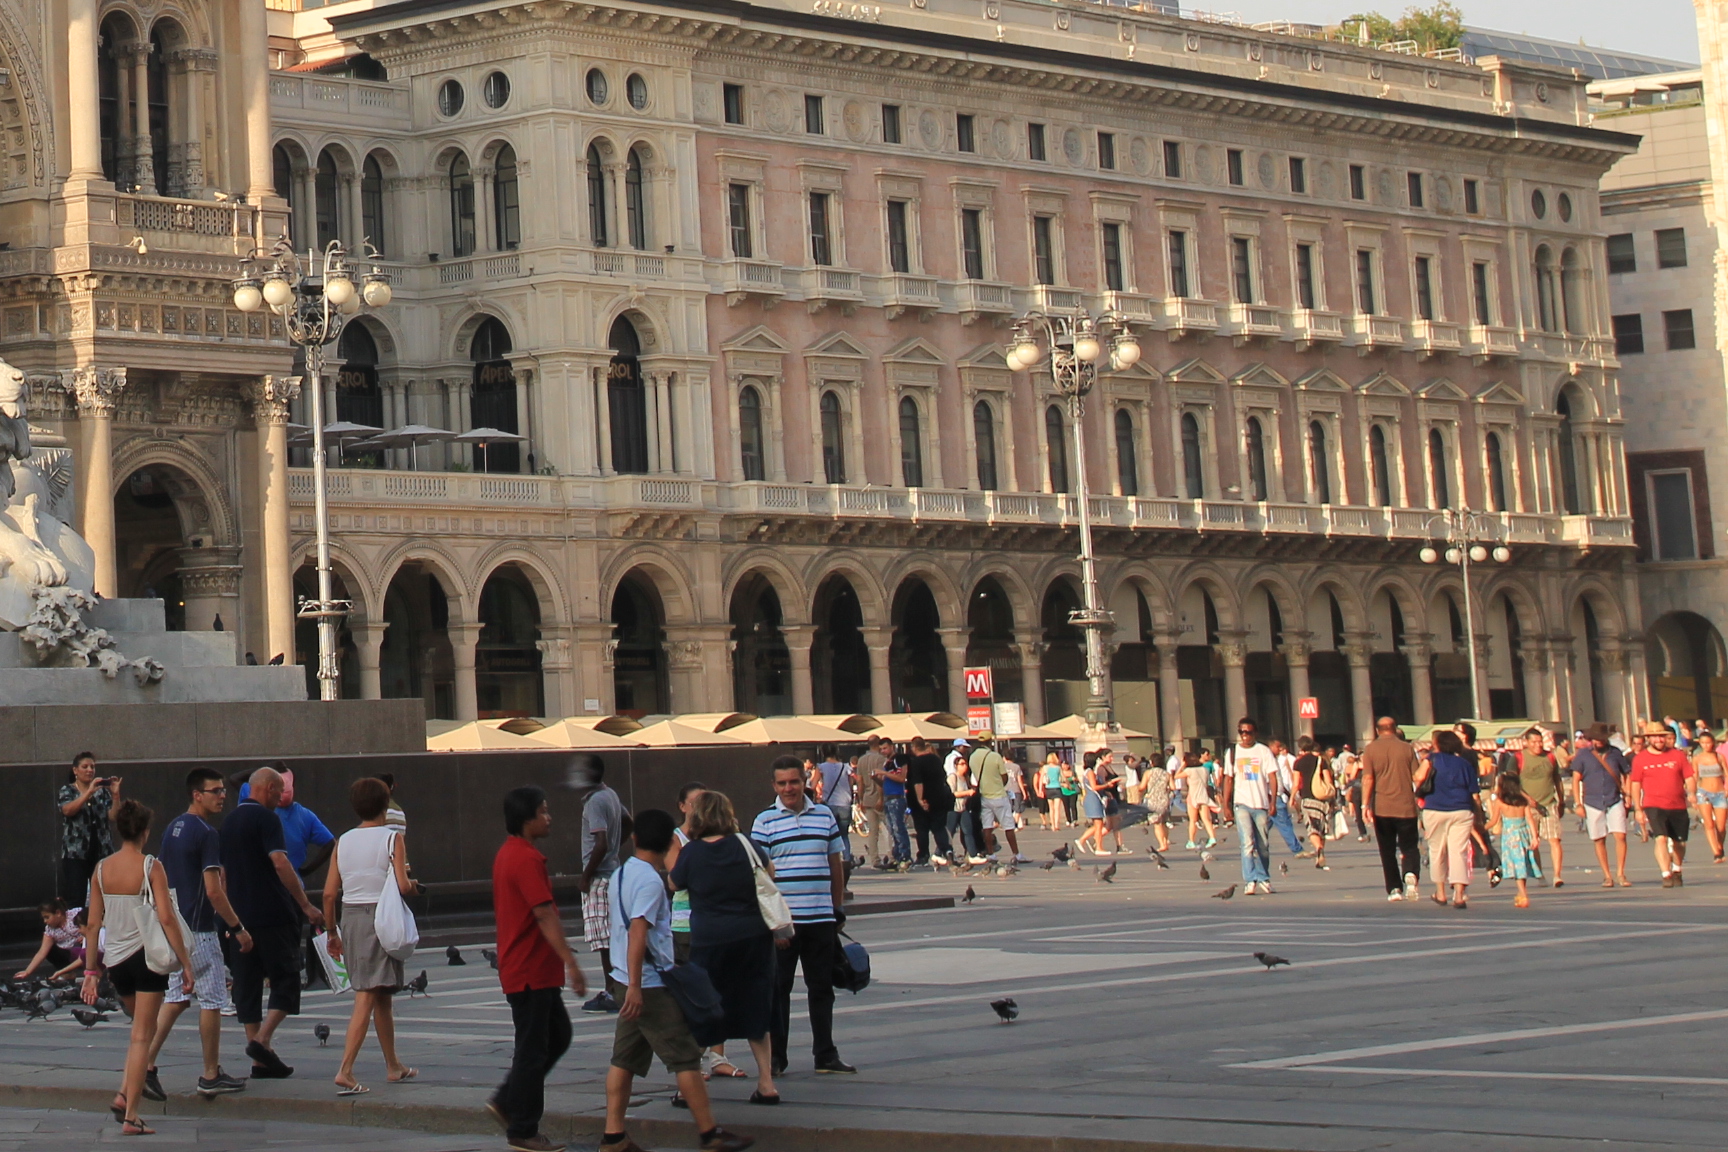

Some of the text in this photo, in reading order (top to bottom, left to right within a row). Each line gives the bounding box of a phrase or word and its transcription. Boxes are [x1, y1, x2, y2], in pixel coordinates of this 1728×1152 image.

[339, 371, 369, 388] EROL
[479, 364, 516, 384] APER
[610, 362, 634, 380] ROL
[967, 673, 988, 695] M
[1301, 701, 1316, 714] M
